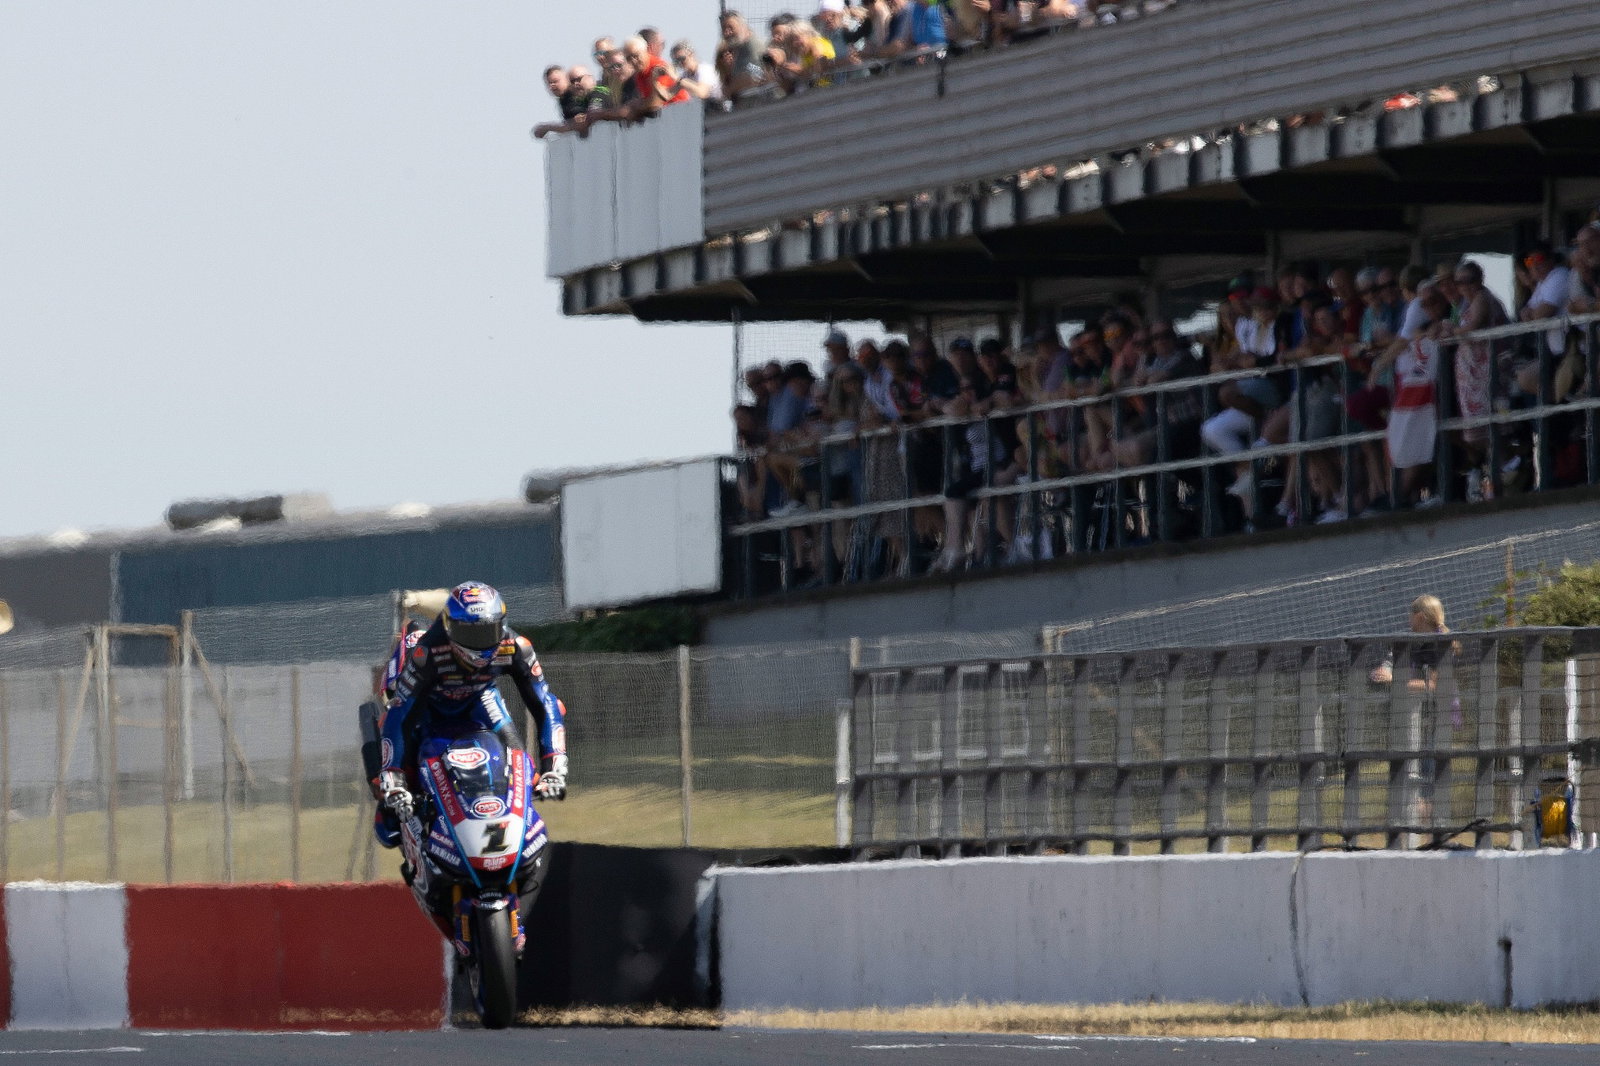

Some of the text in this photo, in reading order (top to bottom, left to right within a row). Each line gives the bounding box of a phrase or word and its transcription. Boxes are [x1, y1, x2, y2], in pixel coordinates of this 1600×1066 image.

[480, 821, 511, 854] 1
[522, 833, 548, 858] YAMAHA
[430, 843, 461, 867] YAMAHA
